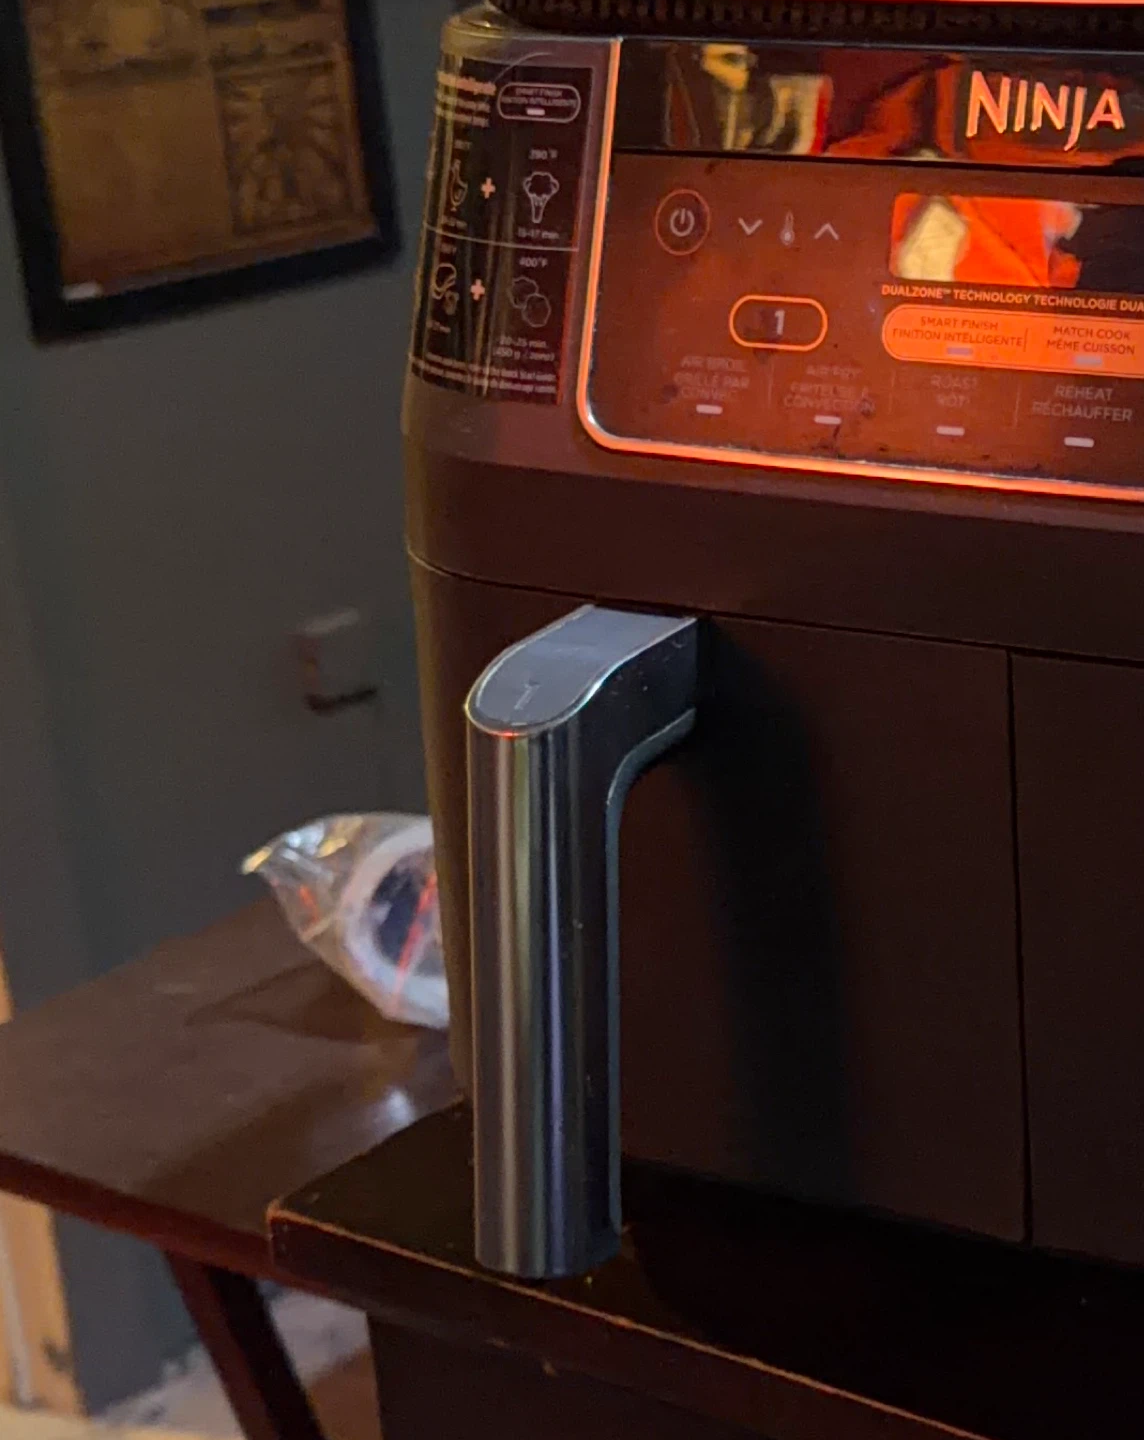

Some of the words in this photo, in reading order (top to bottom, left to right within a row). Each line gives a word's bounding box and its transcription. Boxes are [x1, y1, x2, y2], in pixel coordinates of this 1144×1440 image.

[965, 69, 1126, 151] NINJA
[953, 288, 1031, 304] TECHNOLOGY
[1034, 294, 1117, 310] TECHNOLOGIE
[774, 309, 786, 336] 1
[920, 315, 958, 329] SMART
[961, 318, 999, 331] FINISH
[944, 330, 1024, 348] INTELLIGENTE
[1053, 325, 1094, 339] MATCH
[1096, 328, 1131, 340] COOK
[1083, 341, 1136, 356] CUISSON
[1054, 385, 1114, 403] REHEAT
[1032, 400, 1133, 422] RÉCHAUFFER
